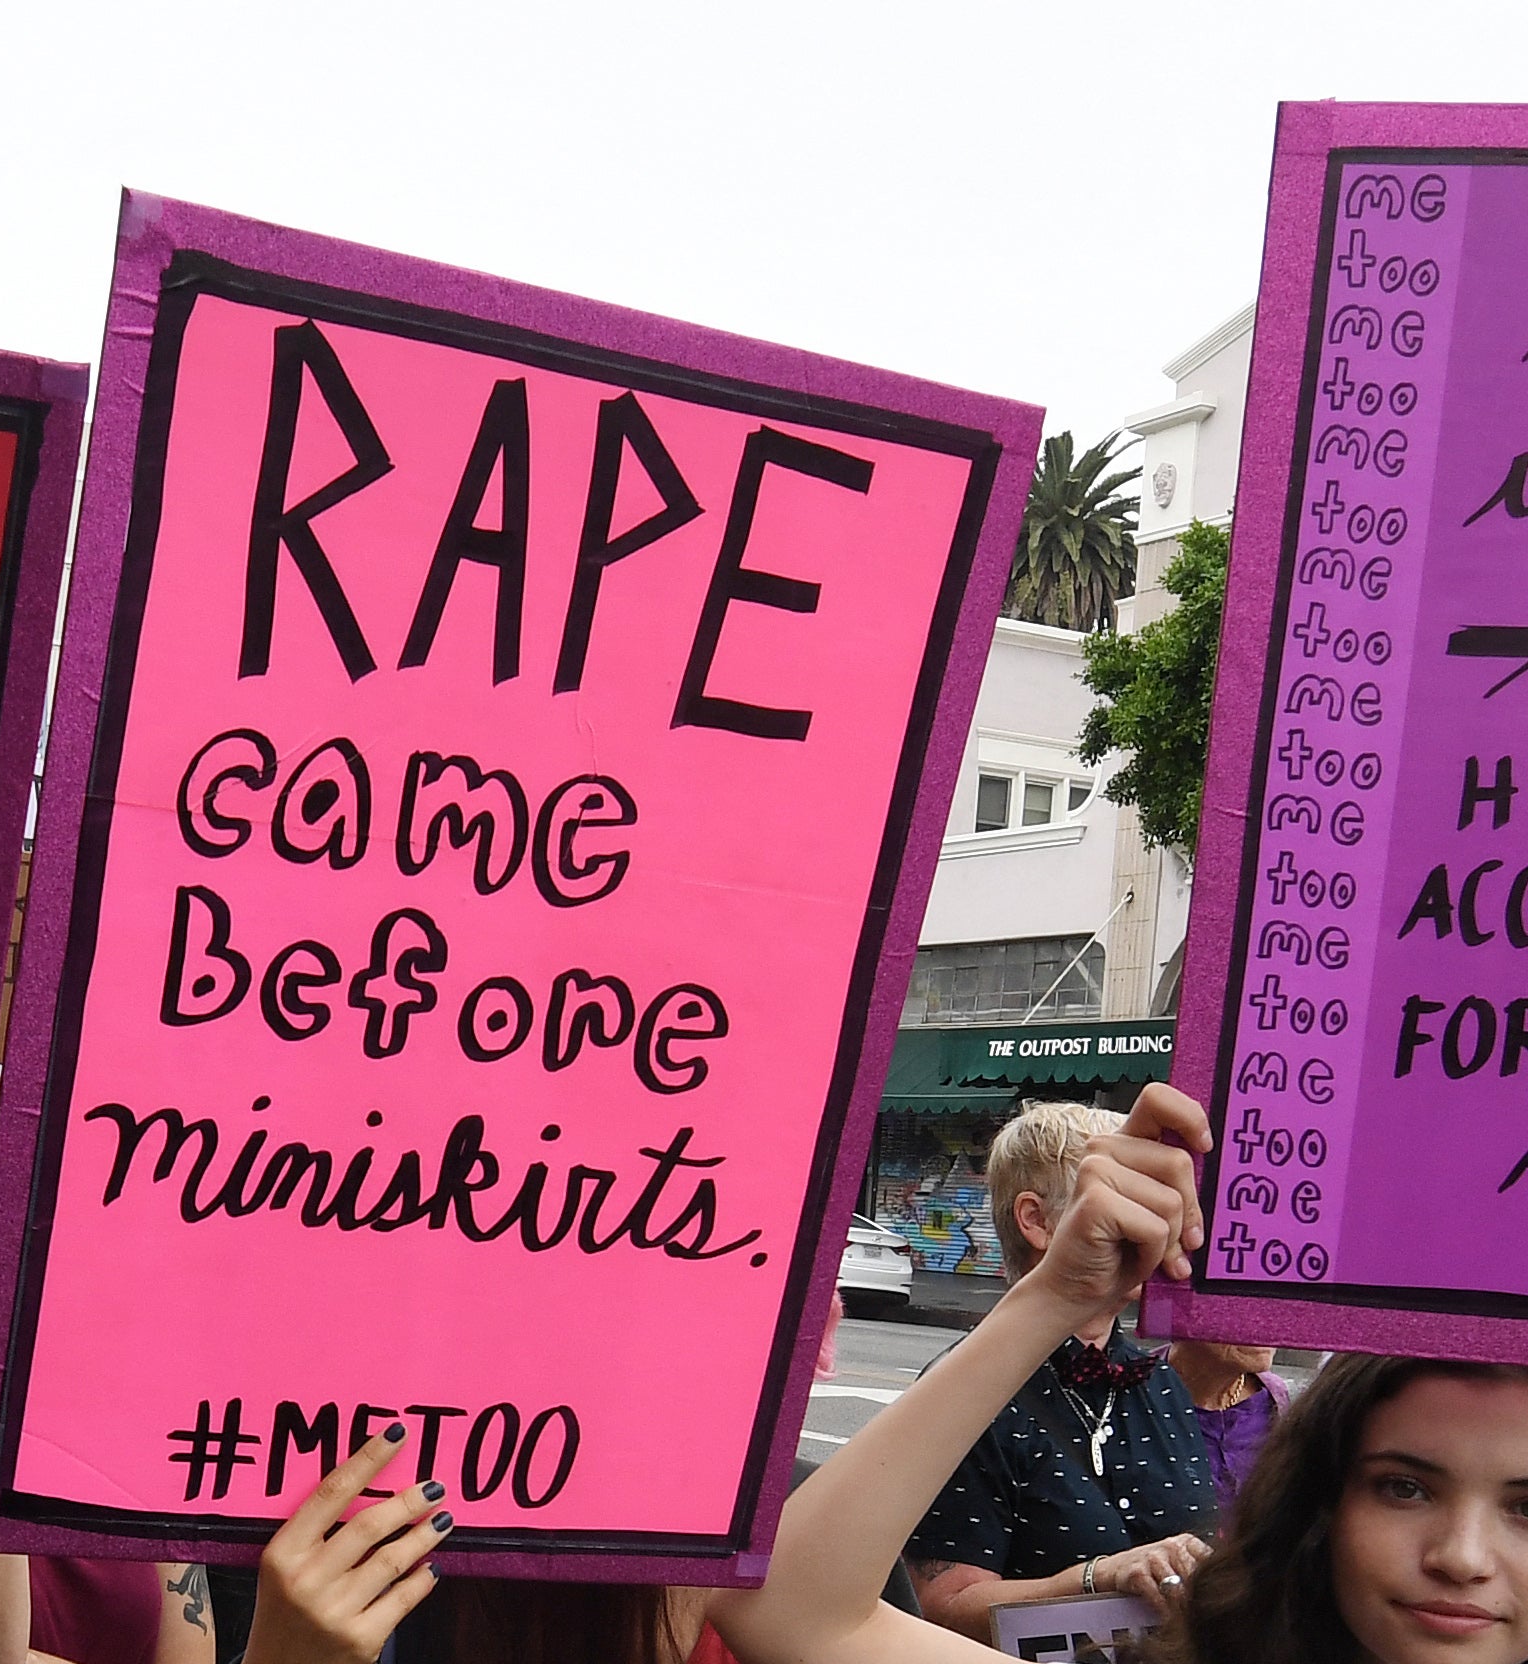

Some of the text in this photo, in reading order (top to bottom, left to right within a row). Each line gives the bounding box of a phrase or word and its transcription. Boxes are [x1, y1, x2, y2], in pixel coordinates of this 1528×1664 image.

[1346, 175, 1446, 222] me
[1338, 229, 1439, 296] too
[1329, 305, 1424, 357] me
[1323, 357, 1417, 415] too
[1315, 425, 1407, 477] me
[238, 318, 874, 743] RAPE
[1312, 480, 1407, 545] too
[1300, 548, 1391, 600] me
[1293, 602, 1391, 665] too
[1284, 674, 1382, 726] me
[1279, 729, 1381, 790] too
[176, 729, 637, 908] came
[1268, 794, 1364, 845] me
[1267, 851, 1356, 909] too
[1256, 921, 1349, 969] me
[160, 885, 728, 1094] Before
[1249, 975, 1348, 1035] too
[988, 1035, 1172, 1057] THE OUTPOST BUILDING
[1237, 1052, 1333, 1104] me
[1233, 1109, 1326, 1167] too
[85, 1096, 767, 1267] miniskirts.
[1227, 1173, 1321, 1223] me
[1218, 1221, 1328, 1281] too
[168, 1398, 580, 1508] #METOO
